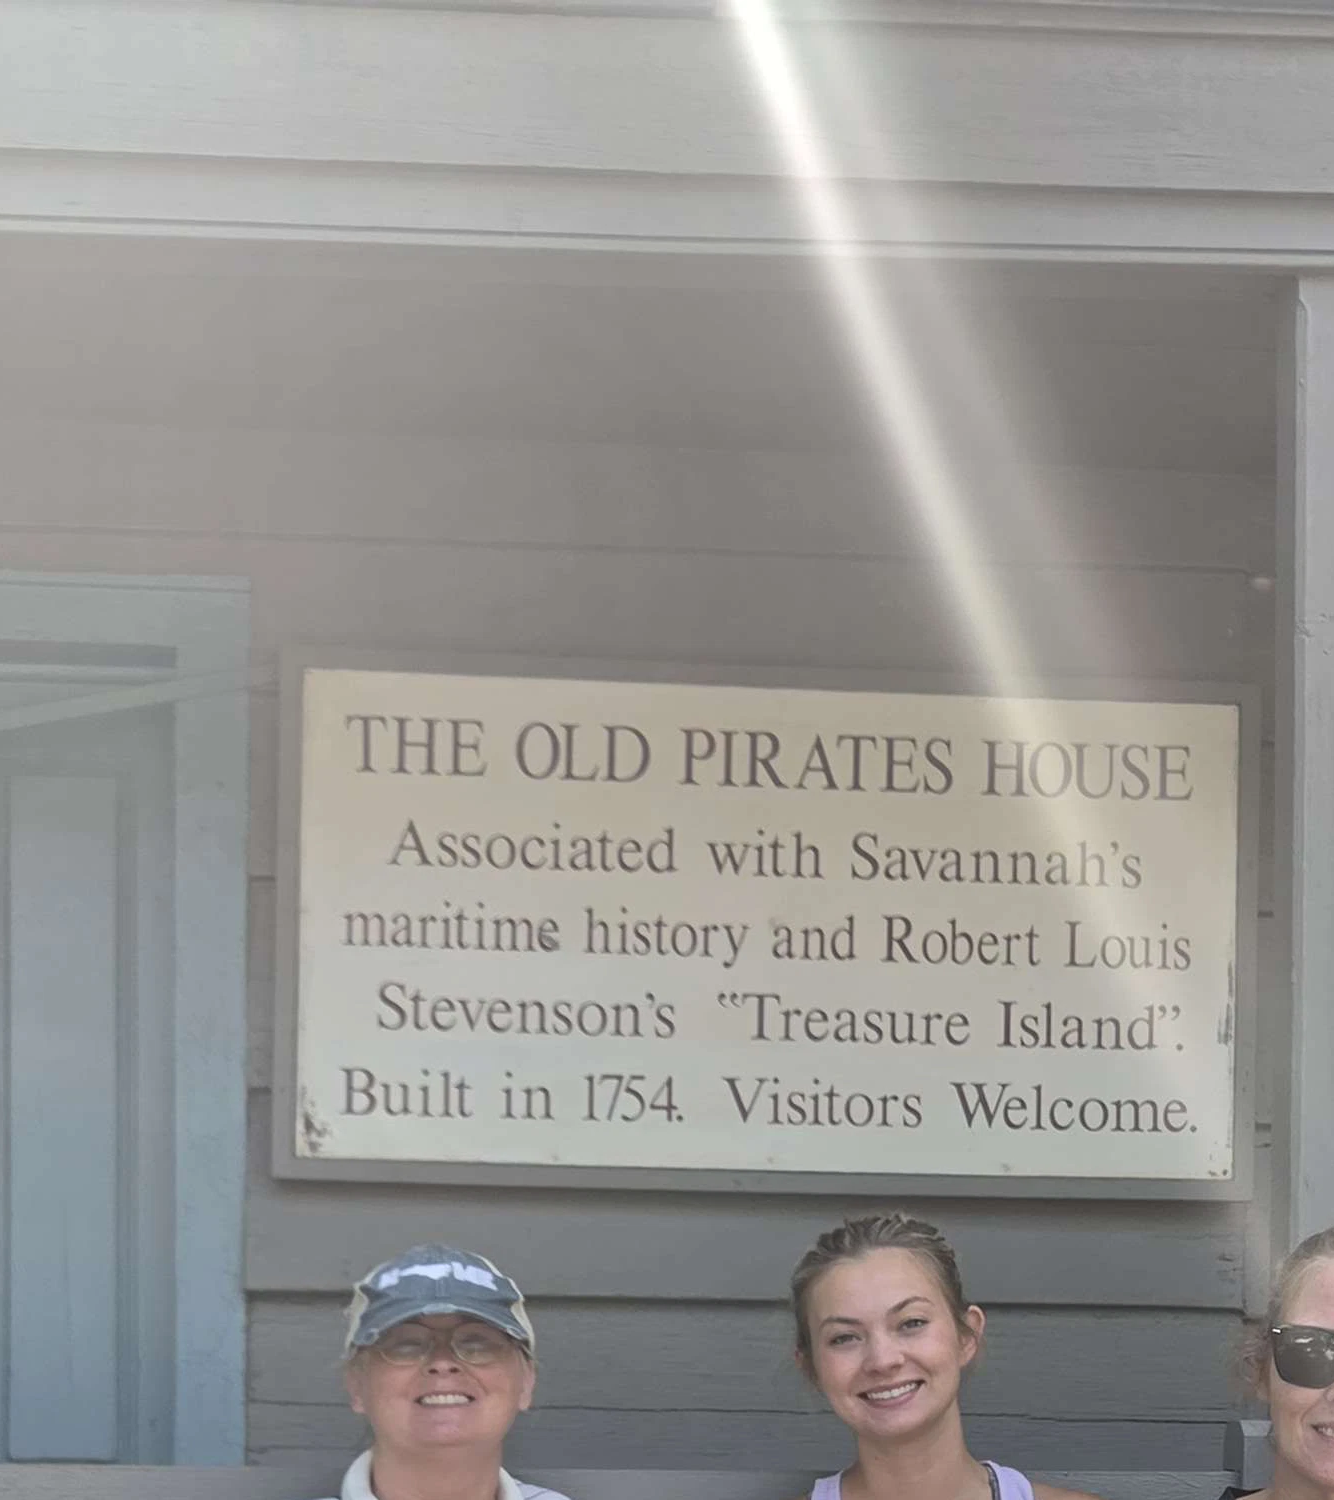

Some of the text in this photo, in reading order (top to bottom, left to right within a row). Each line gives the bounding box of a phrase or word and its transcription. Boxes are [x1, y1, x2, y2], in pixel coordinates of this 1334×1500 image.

[346, 715, 1193, 800] THE OLD PIRATES HOUSE
[387, 820, 1142, 888] Associated with Savannah’s
[343, 900, 1192, 971] maritime history and Robert Louis
[377, 981, 676, 1039] Stevenson’s
[717, 991, 970, 1046] “Treasure
[340, 1067, 1198, 1133] Built in 1754. Visitors Welcome.
